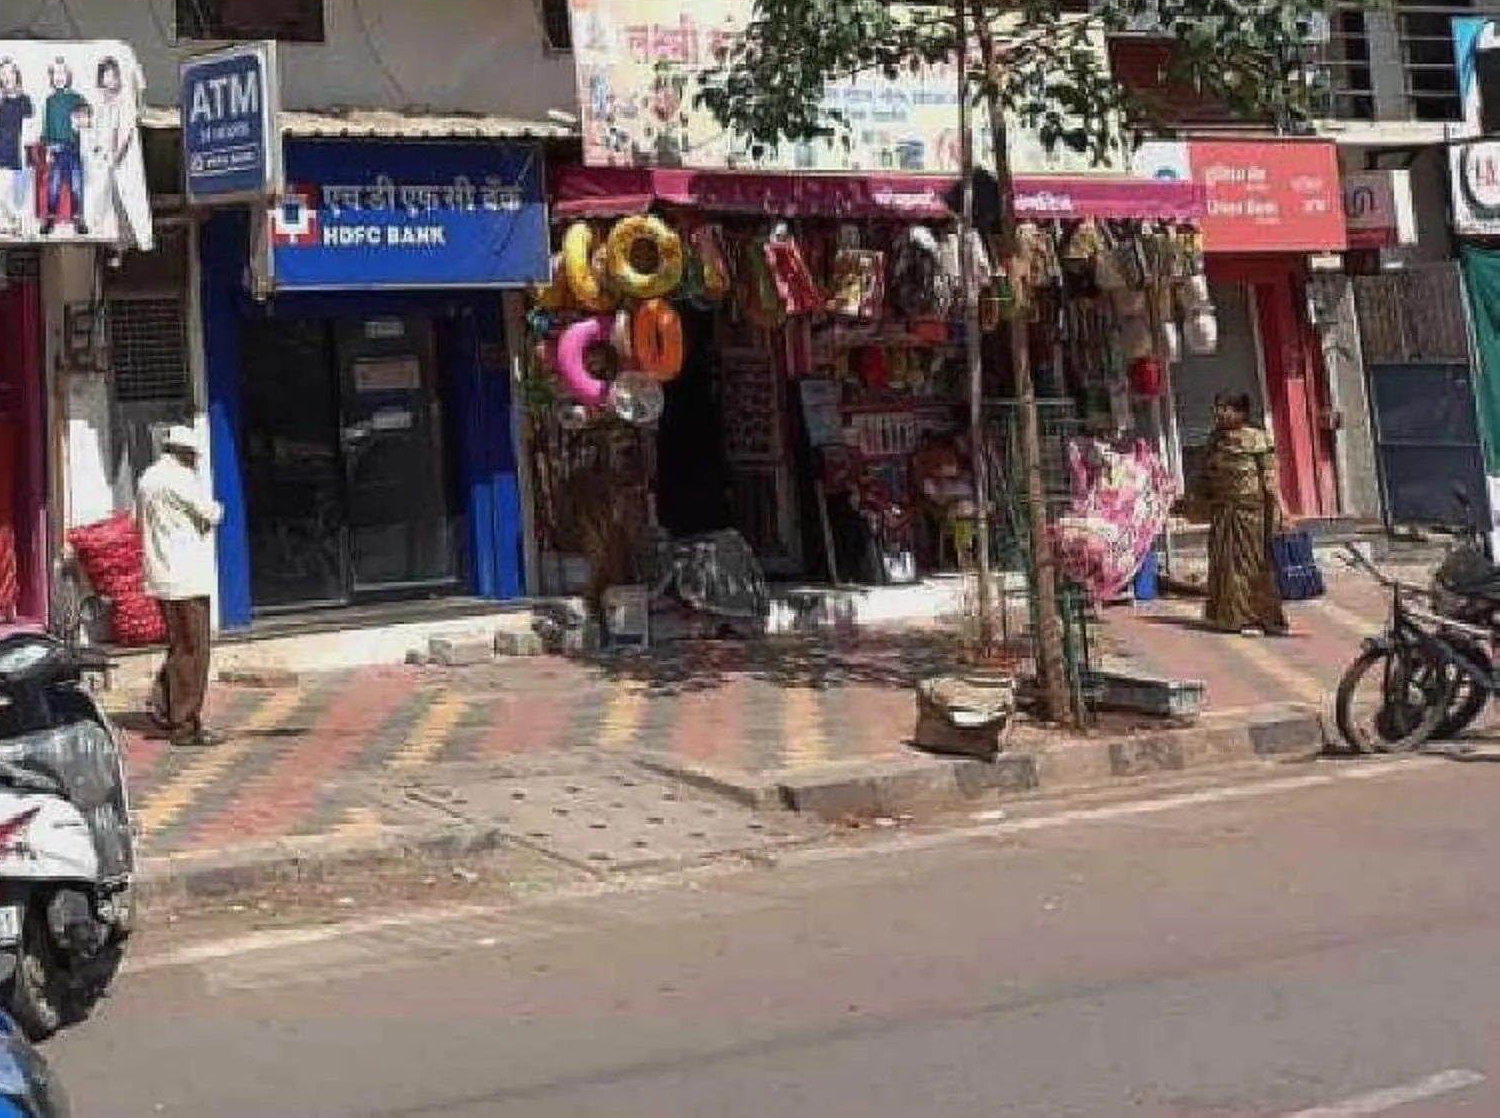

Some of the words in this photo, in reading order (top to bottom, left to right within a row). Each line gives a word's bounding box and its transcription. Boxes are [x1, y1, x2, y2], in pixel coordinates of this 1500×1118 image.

[189, 69, 260, 123] ATM
[322, 224, 382, 246] HDFC
[386, 224, 447, 246] BANK
